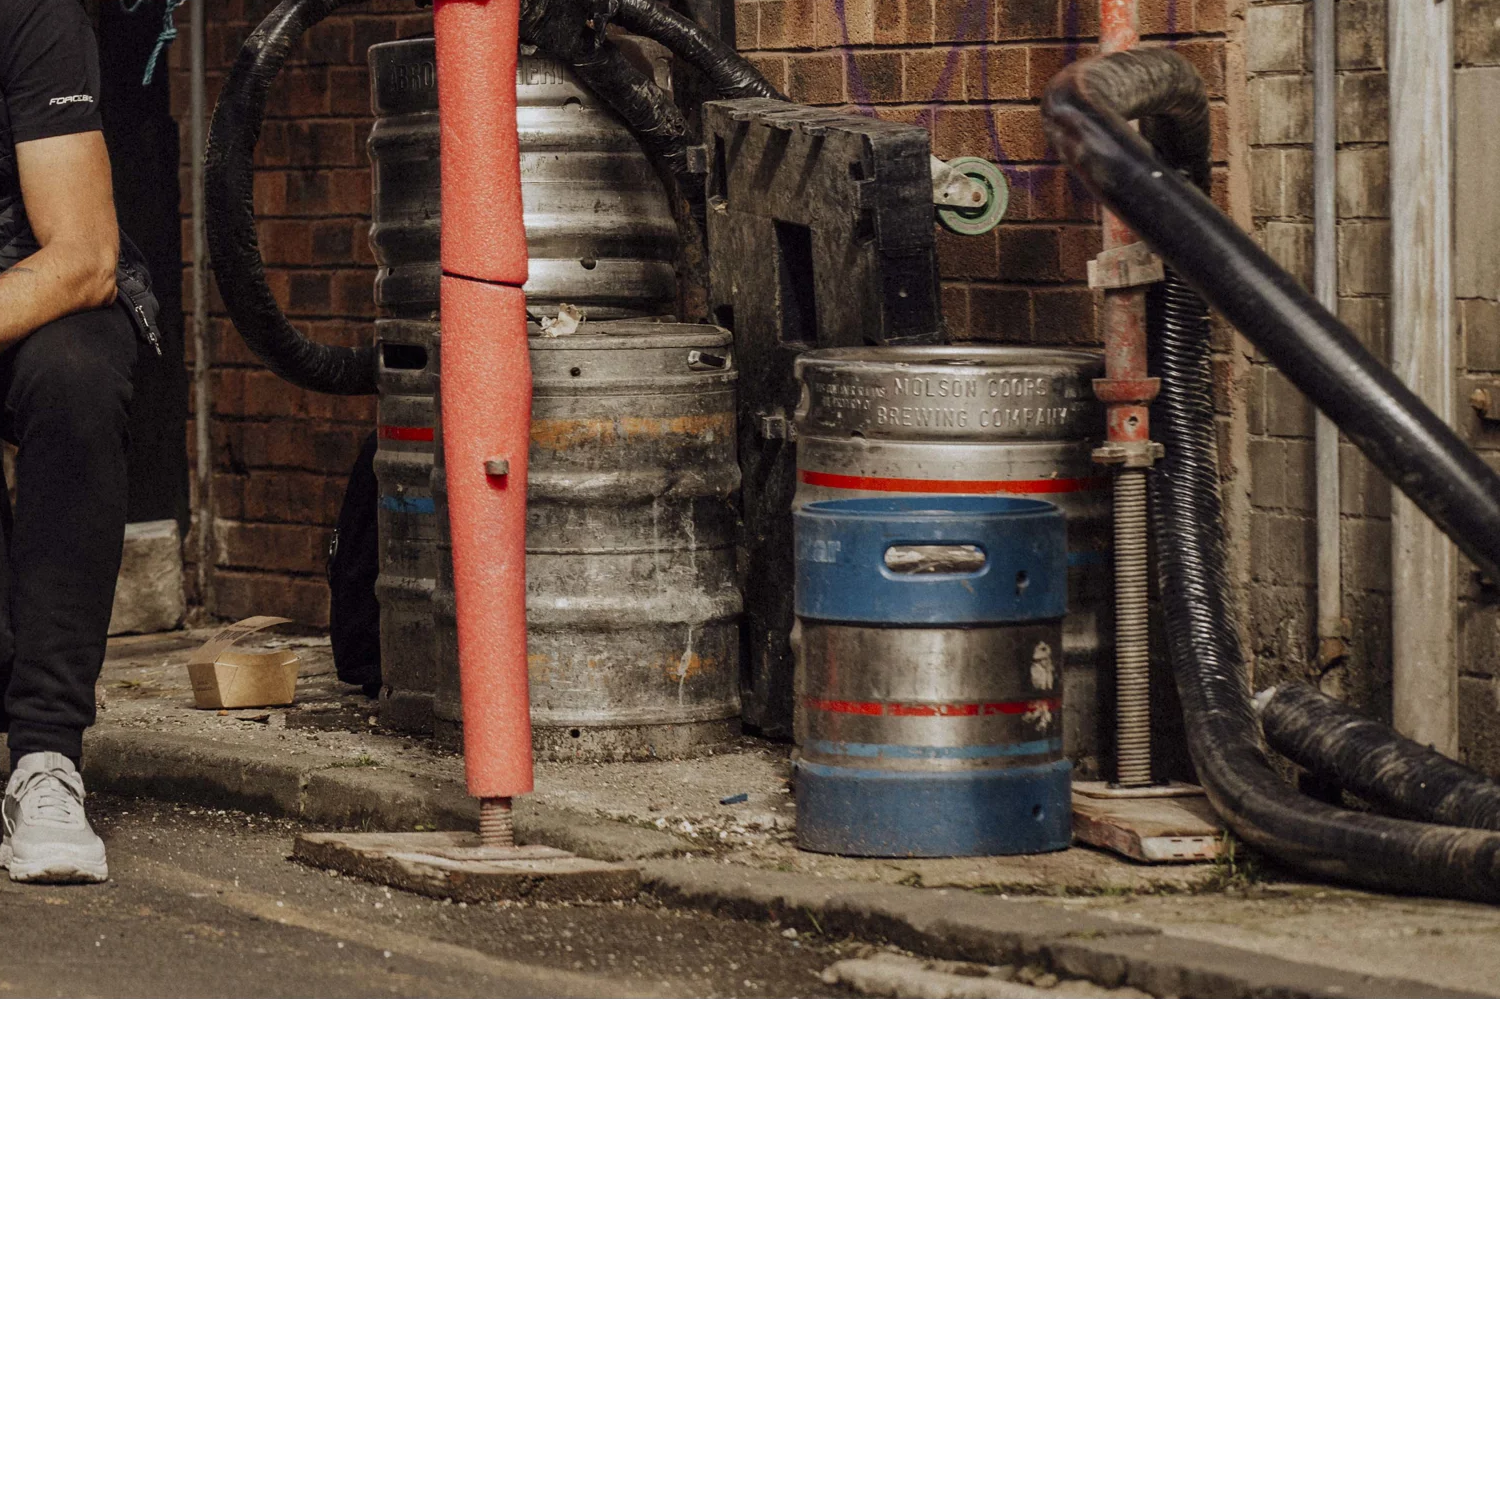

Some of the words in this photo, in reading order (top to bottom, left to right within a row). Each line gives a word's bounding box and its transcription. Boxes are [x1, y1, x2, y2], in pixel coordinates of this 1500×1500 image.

[894, 377, 977, 398] MOLSON
[876, 406, 968, 427] BREWING
[979, 407, 1068, 427] COMPANY
